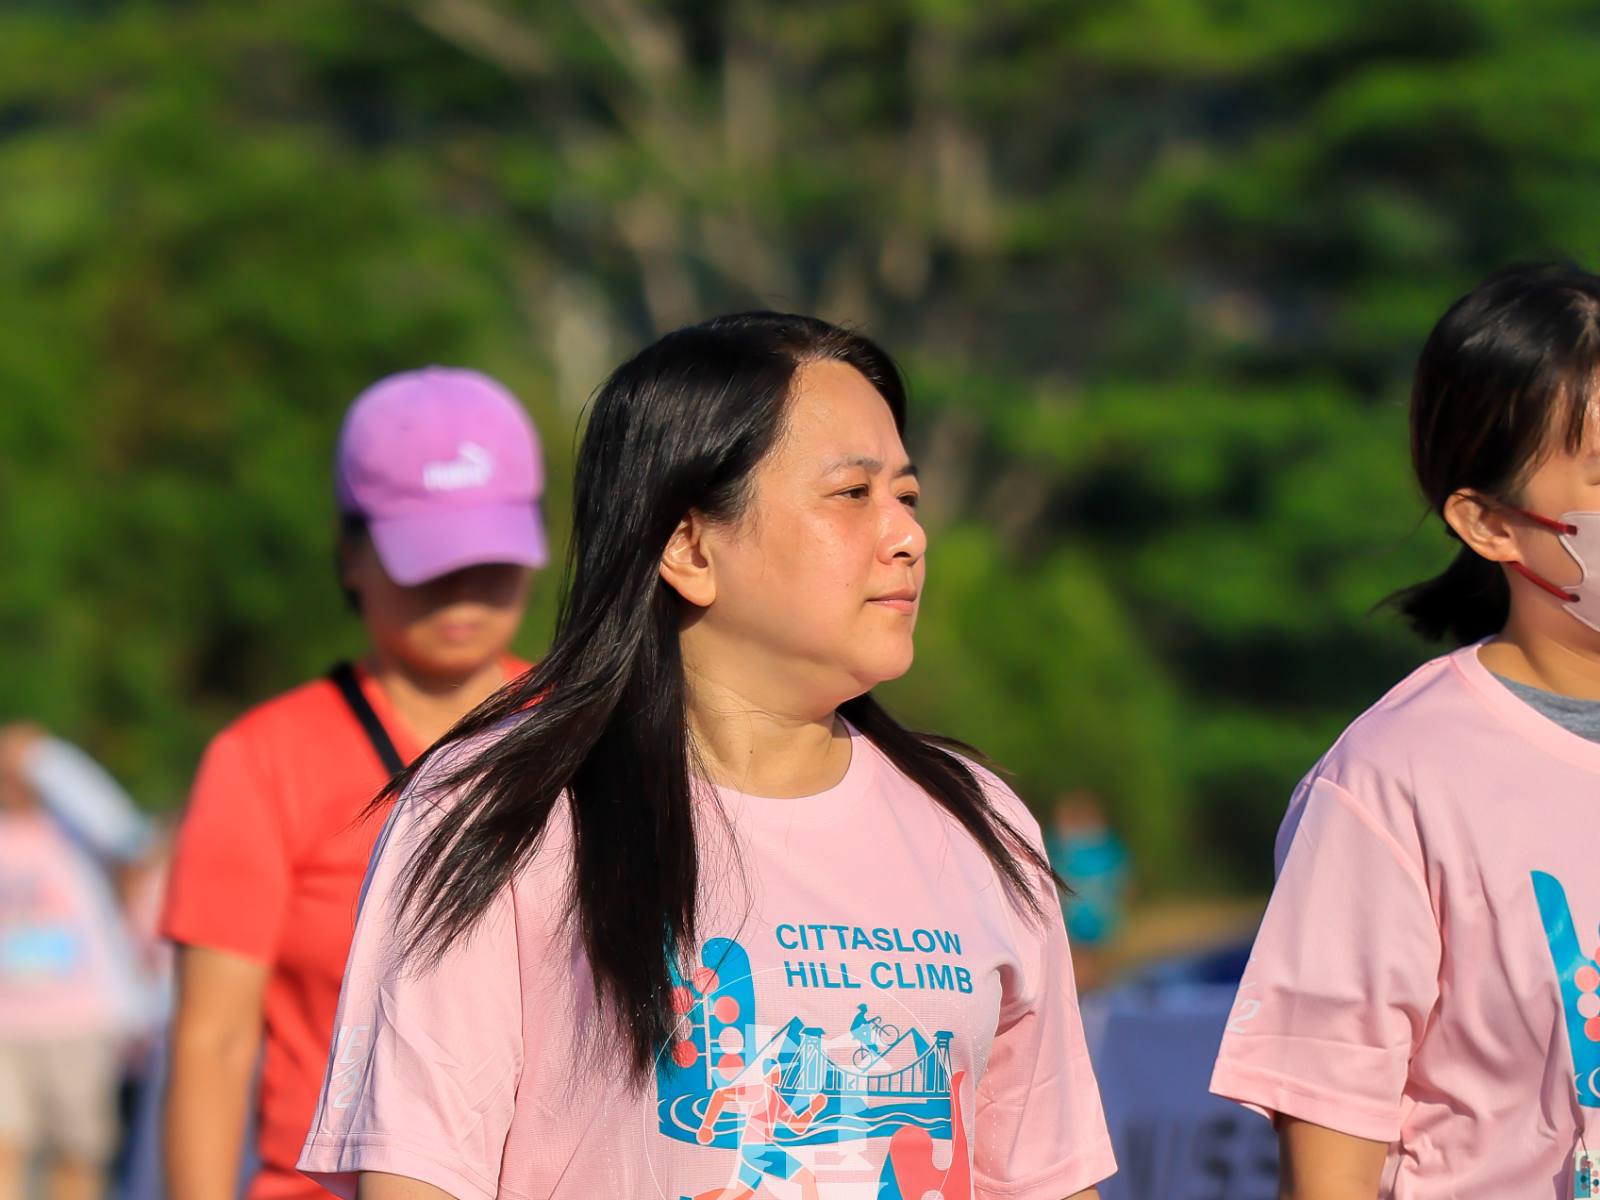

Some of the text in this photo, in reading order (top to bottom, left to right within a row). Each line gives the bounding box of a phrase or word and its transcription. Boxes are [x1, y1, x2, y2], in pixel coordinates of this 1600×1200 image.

[776, 923, 963, 956] CITTASLOW
[784, 961, 974, 994] HILL CLIMB
